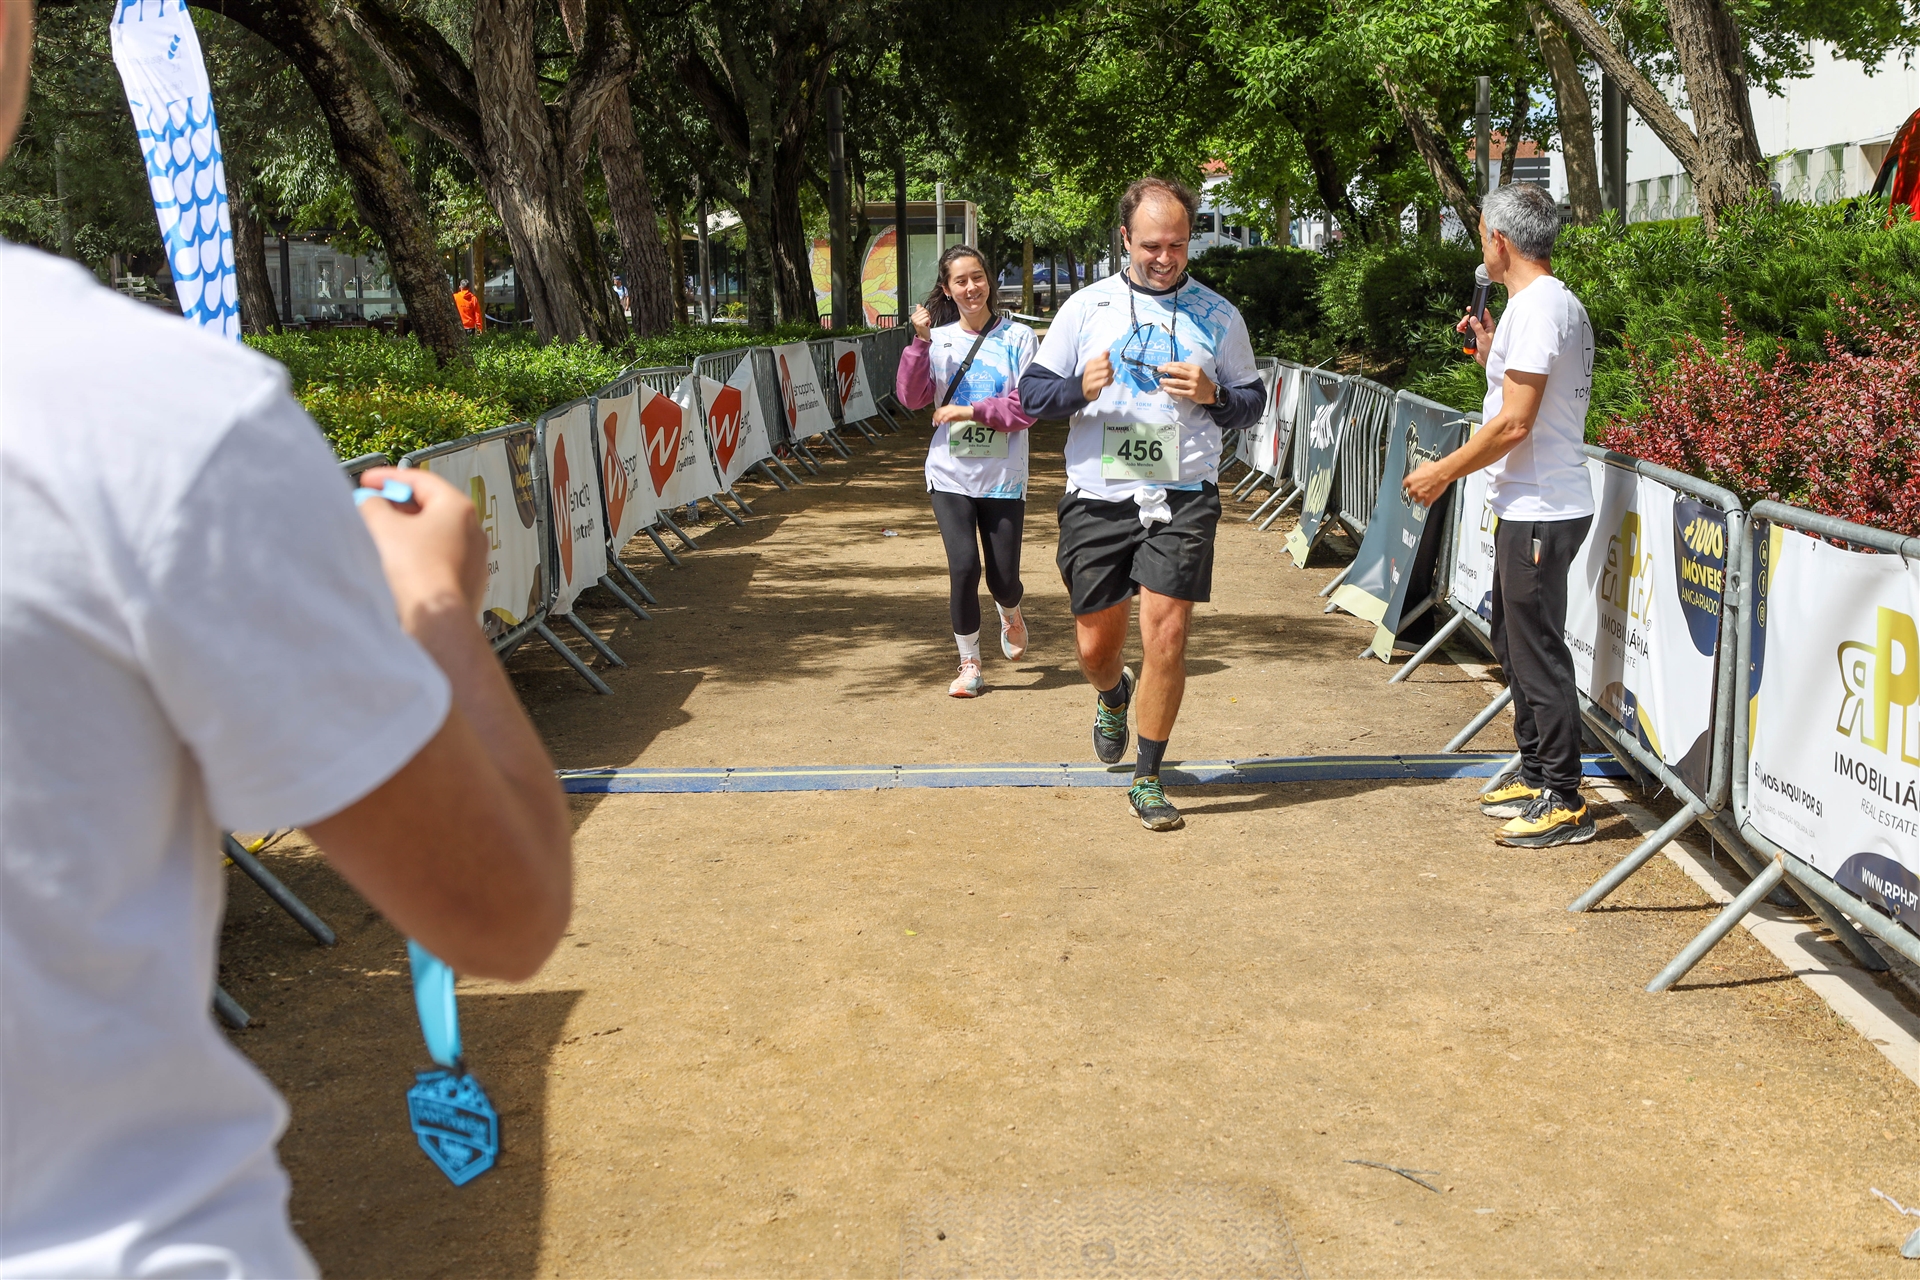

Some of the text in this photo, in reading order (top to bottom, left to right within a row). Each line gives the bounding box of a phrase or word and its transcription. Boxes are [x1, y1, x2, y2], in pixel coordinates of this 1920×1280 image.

[962, 426, 996, 443] 457
[1117, 439, 1163, 462] 456
[1683, 517, 1723, 560] +1000
[1681, 556, 1722, 594] IMÓVEIS
[1681, 586, 1720, 616] ANGARIADO
[1601, 612, 1650, 660] IMOBILIÁRIA
[1781, 780, 1801, 803] AQUI
[1801, 790, 1816, 814] POR
[1816, 800, 1823, 819] SI
[1834, 752, 1920, 812] IMOBILIÁ
[1861, 798, 1918, 838] REAL ESTATE
[1861, 866, 1919, 912] WWW.RPH.PT
